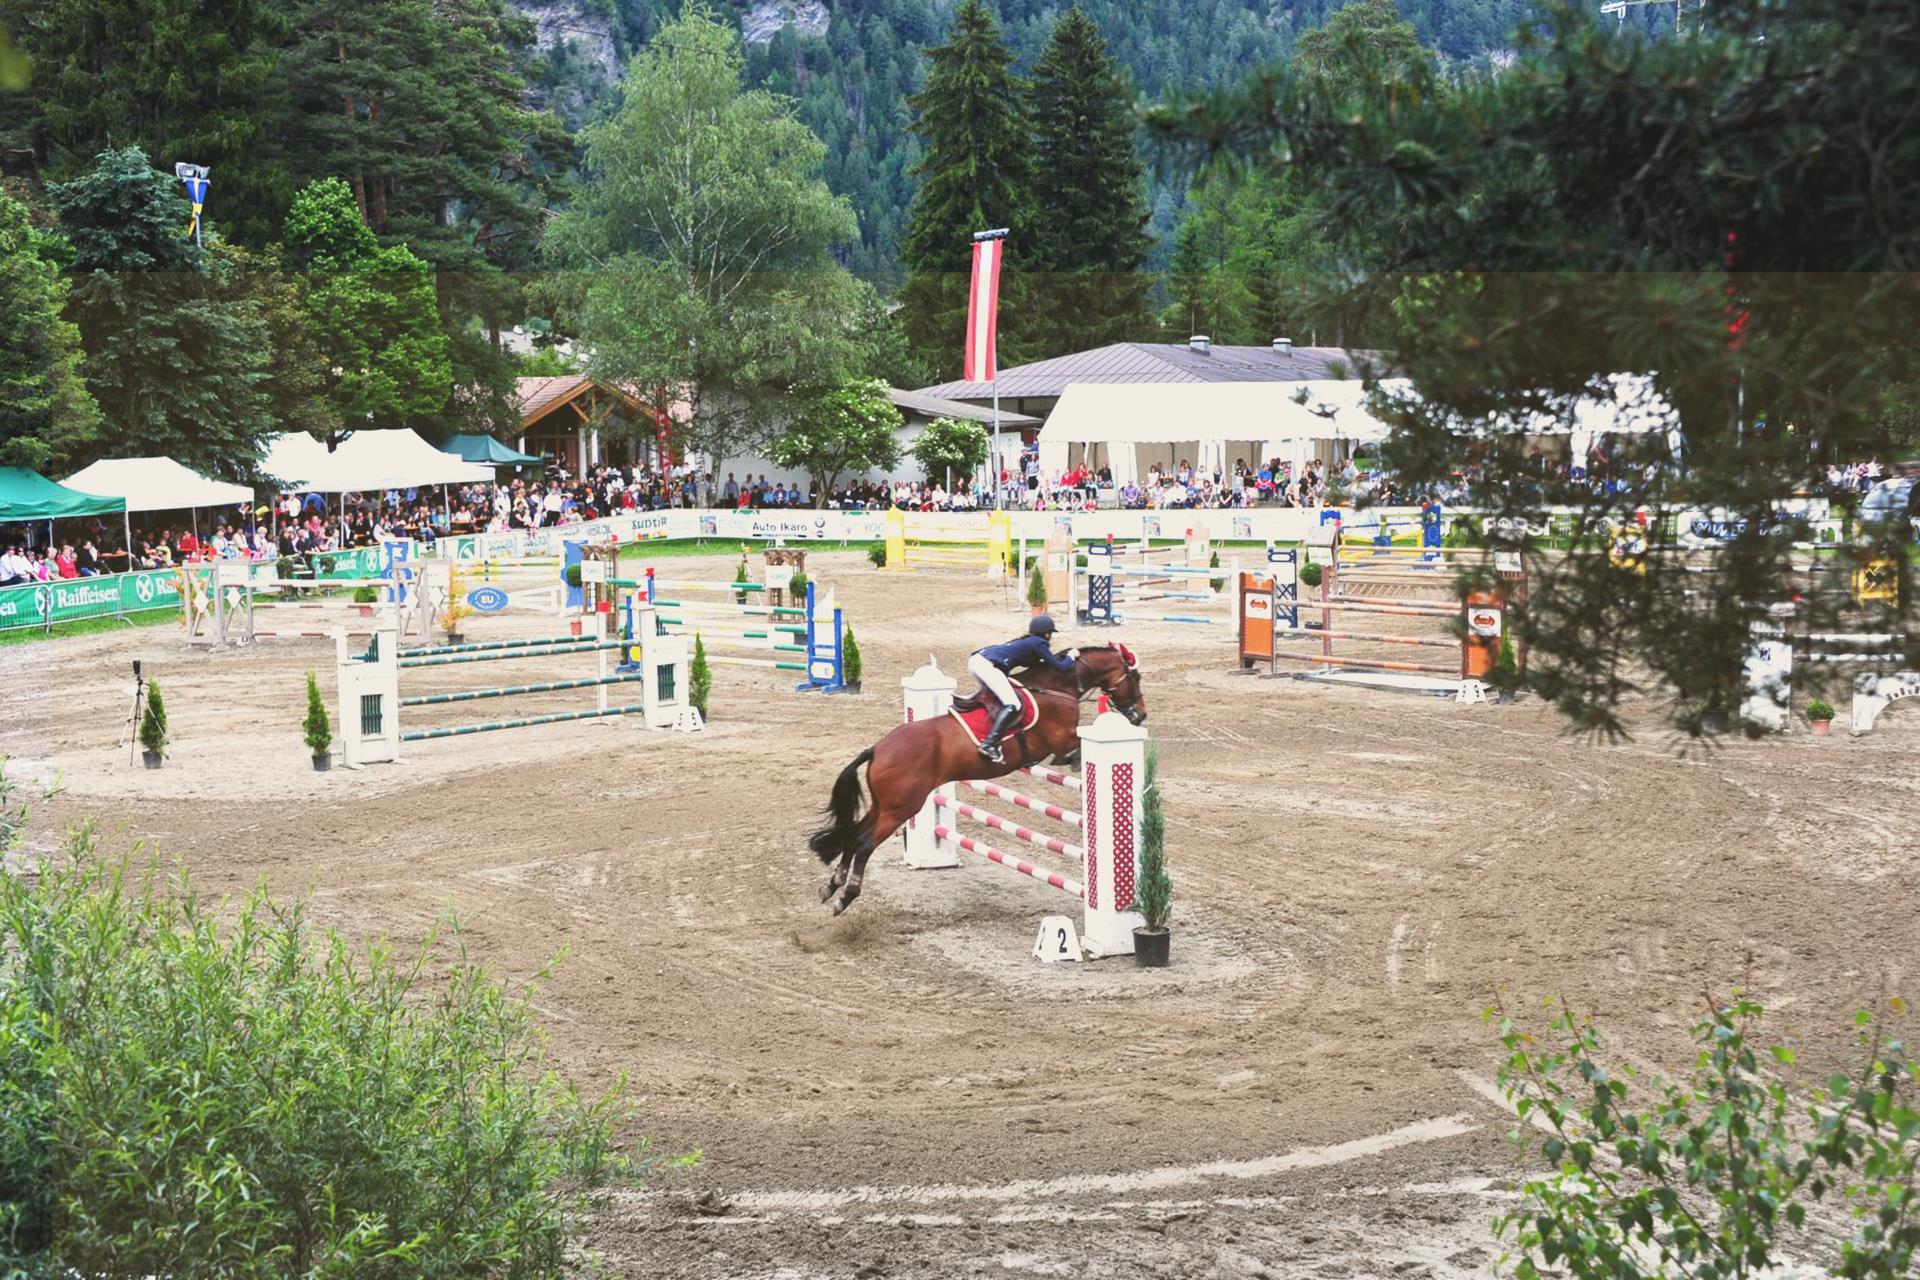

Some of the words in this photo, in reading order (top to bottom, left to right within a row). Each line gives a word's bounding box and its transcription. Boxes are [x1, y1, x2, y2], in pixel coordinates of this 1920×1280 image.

[753, 522, 776, 531] Auto
[781, 522, 808, 531] Ikaro
[56, 585, 120, 608] Raiffeisen
[481, 595, 494, 604] EU
[1058, 928, 1067, 953] 2
